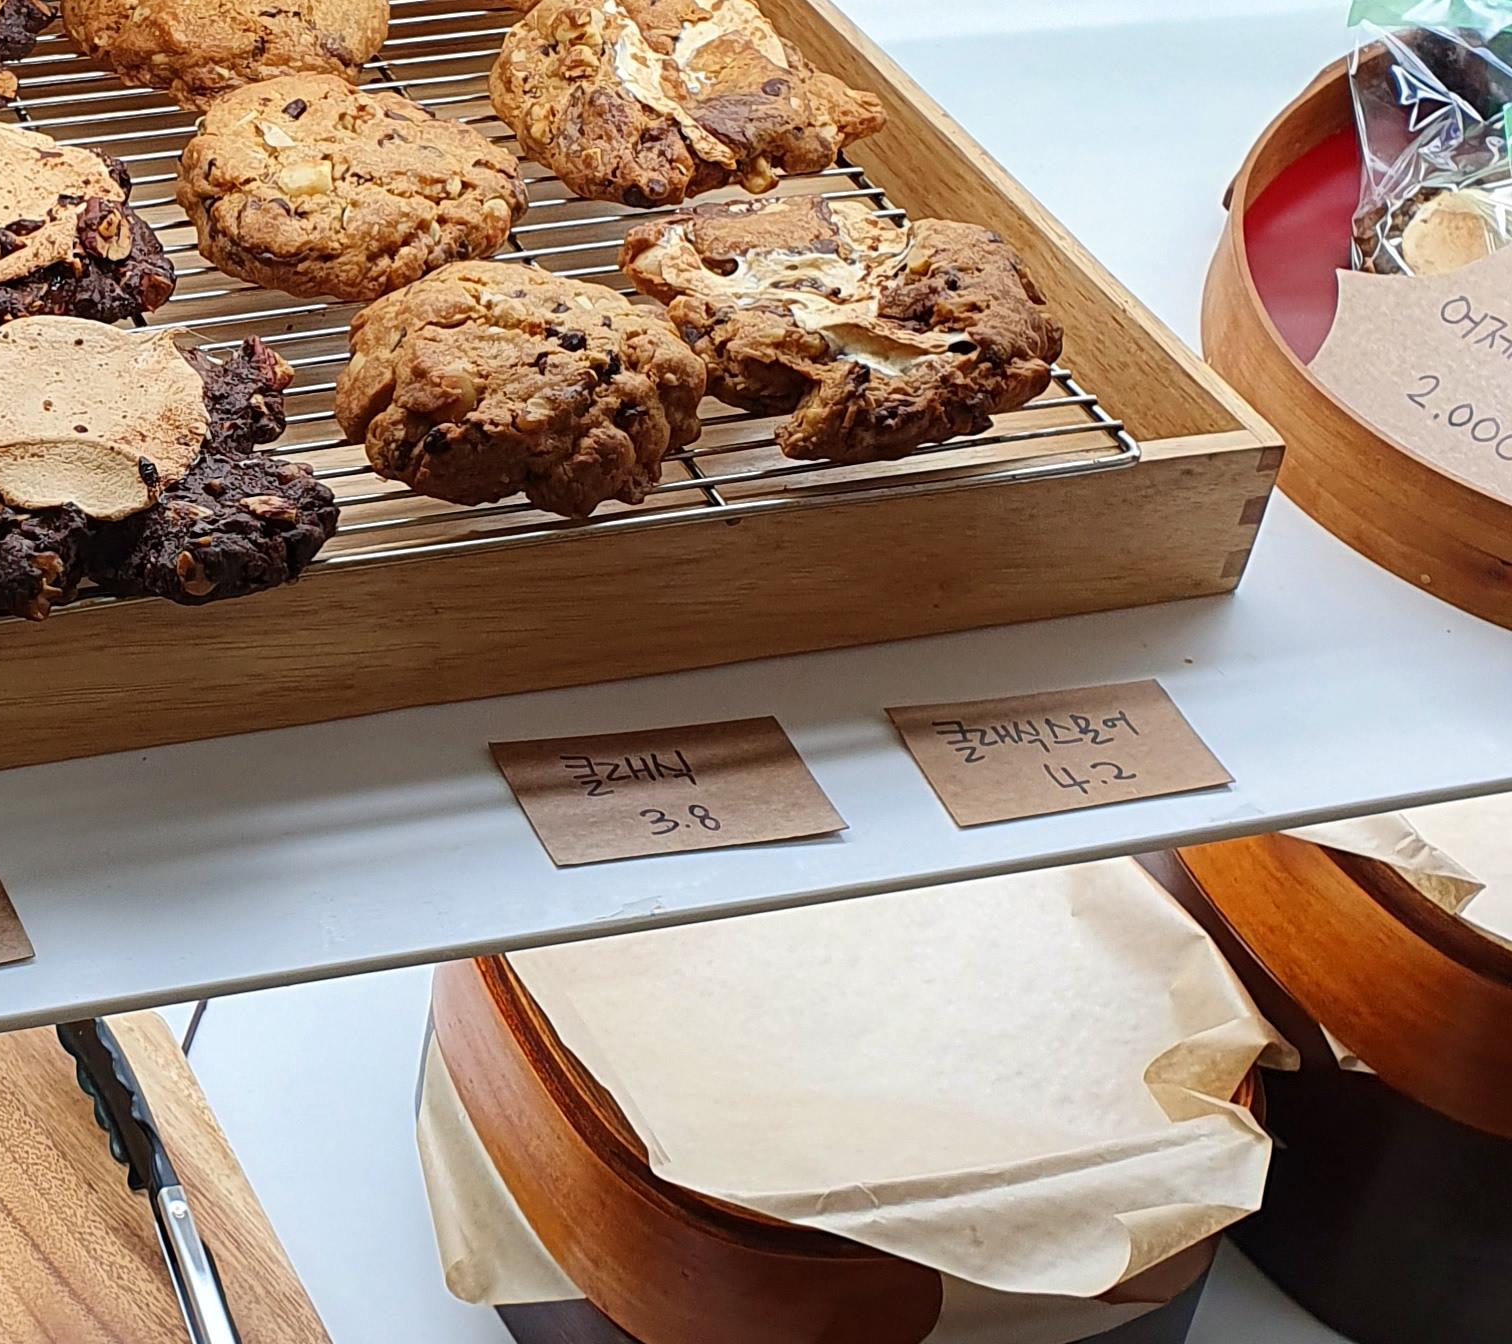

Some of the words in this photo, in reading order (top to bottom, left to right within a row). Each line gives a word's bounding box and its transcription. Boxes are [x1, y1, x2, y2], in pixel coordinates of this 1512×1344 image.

[559, 749, 698, 798] 클래식
[1043, 760, 1138, 795] 4.2
[639, 803, 722, 836] 3.8
